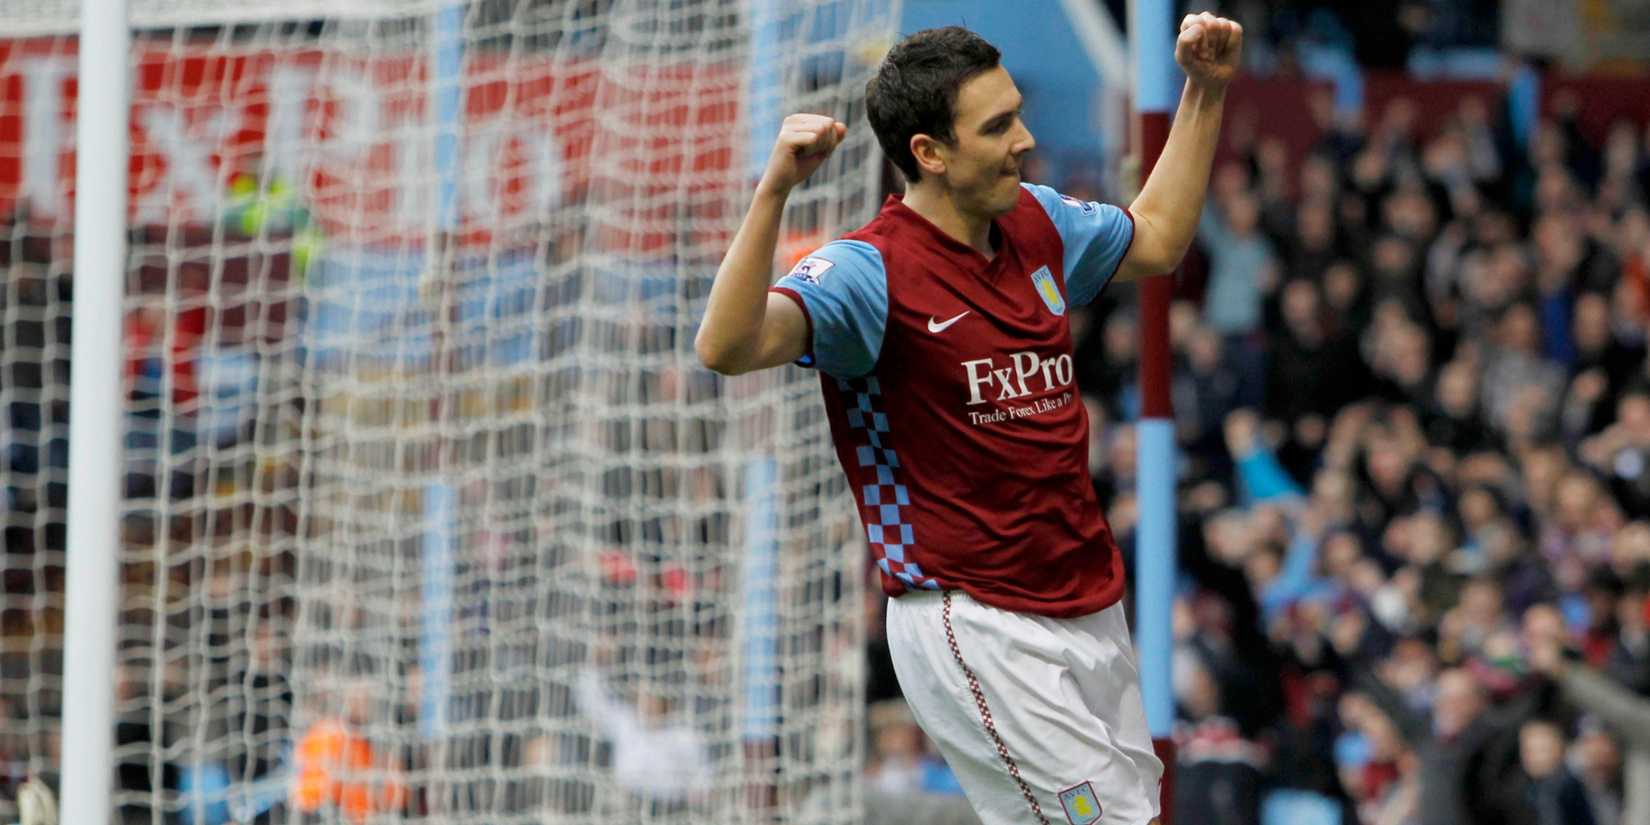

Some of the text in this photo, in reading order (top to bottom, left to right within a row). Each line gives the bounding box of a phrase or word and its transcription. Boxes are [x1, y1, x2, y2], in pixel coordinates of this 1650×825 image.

[961, 351, 1073, 406] FxPro
[968, 409, 1007, 425] Trade
[1008, 406, 1036, 419] Forex
[1034, 398, 1056, 414] Like
[1056, 399, 1063, 407] a
